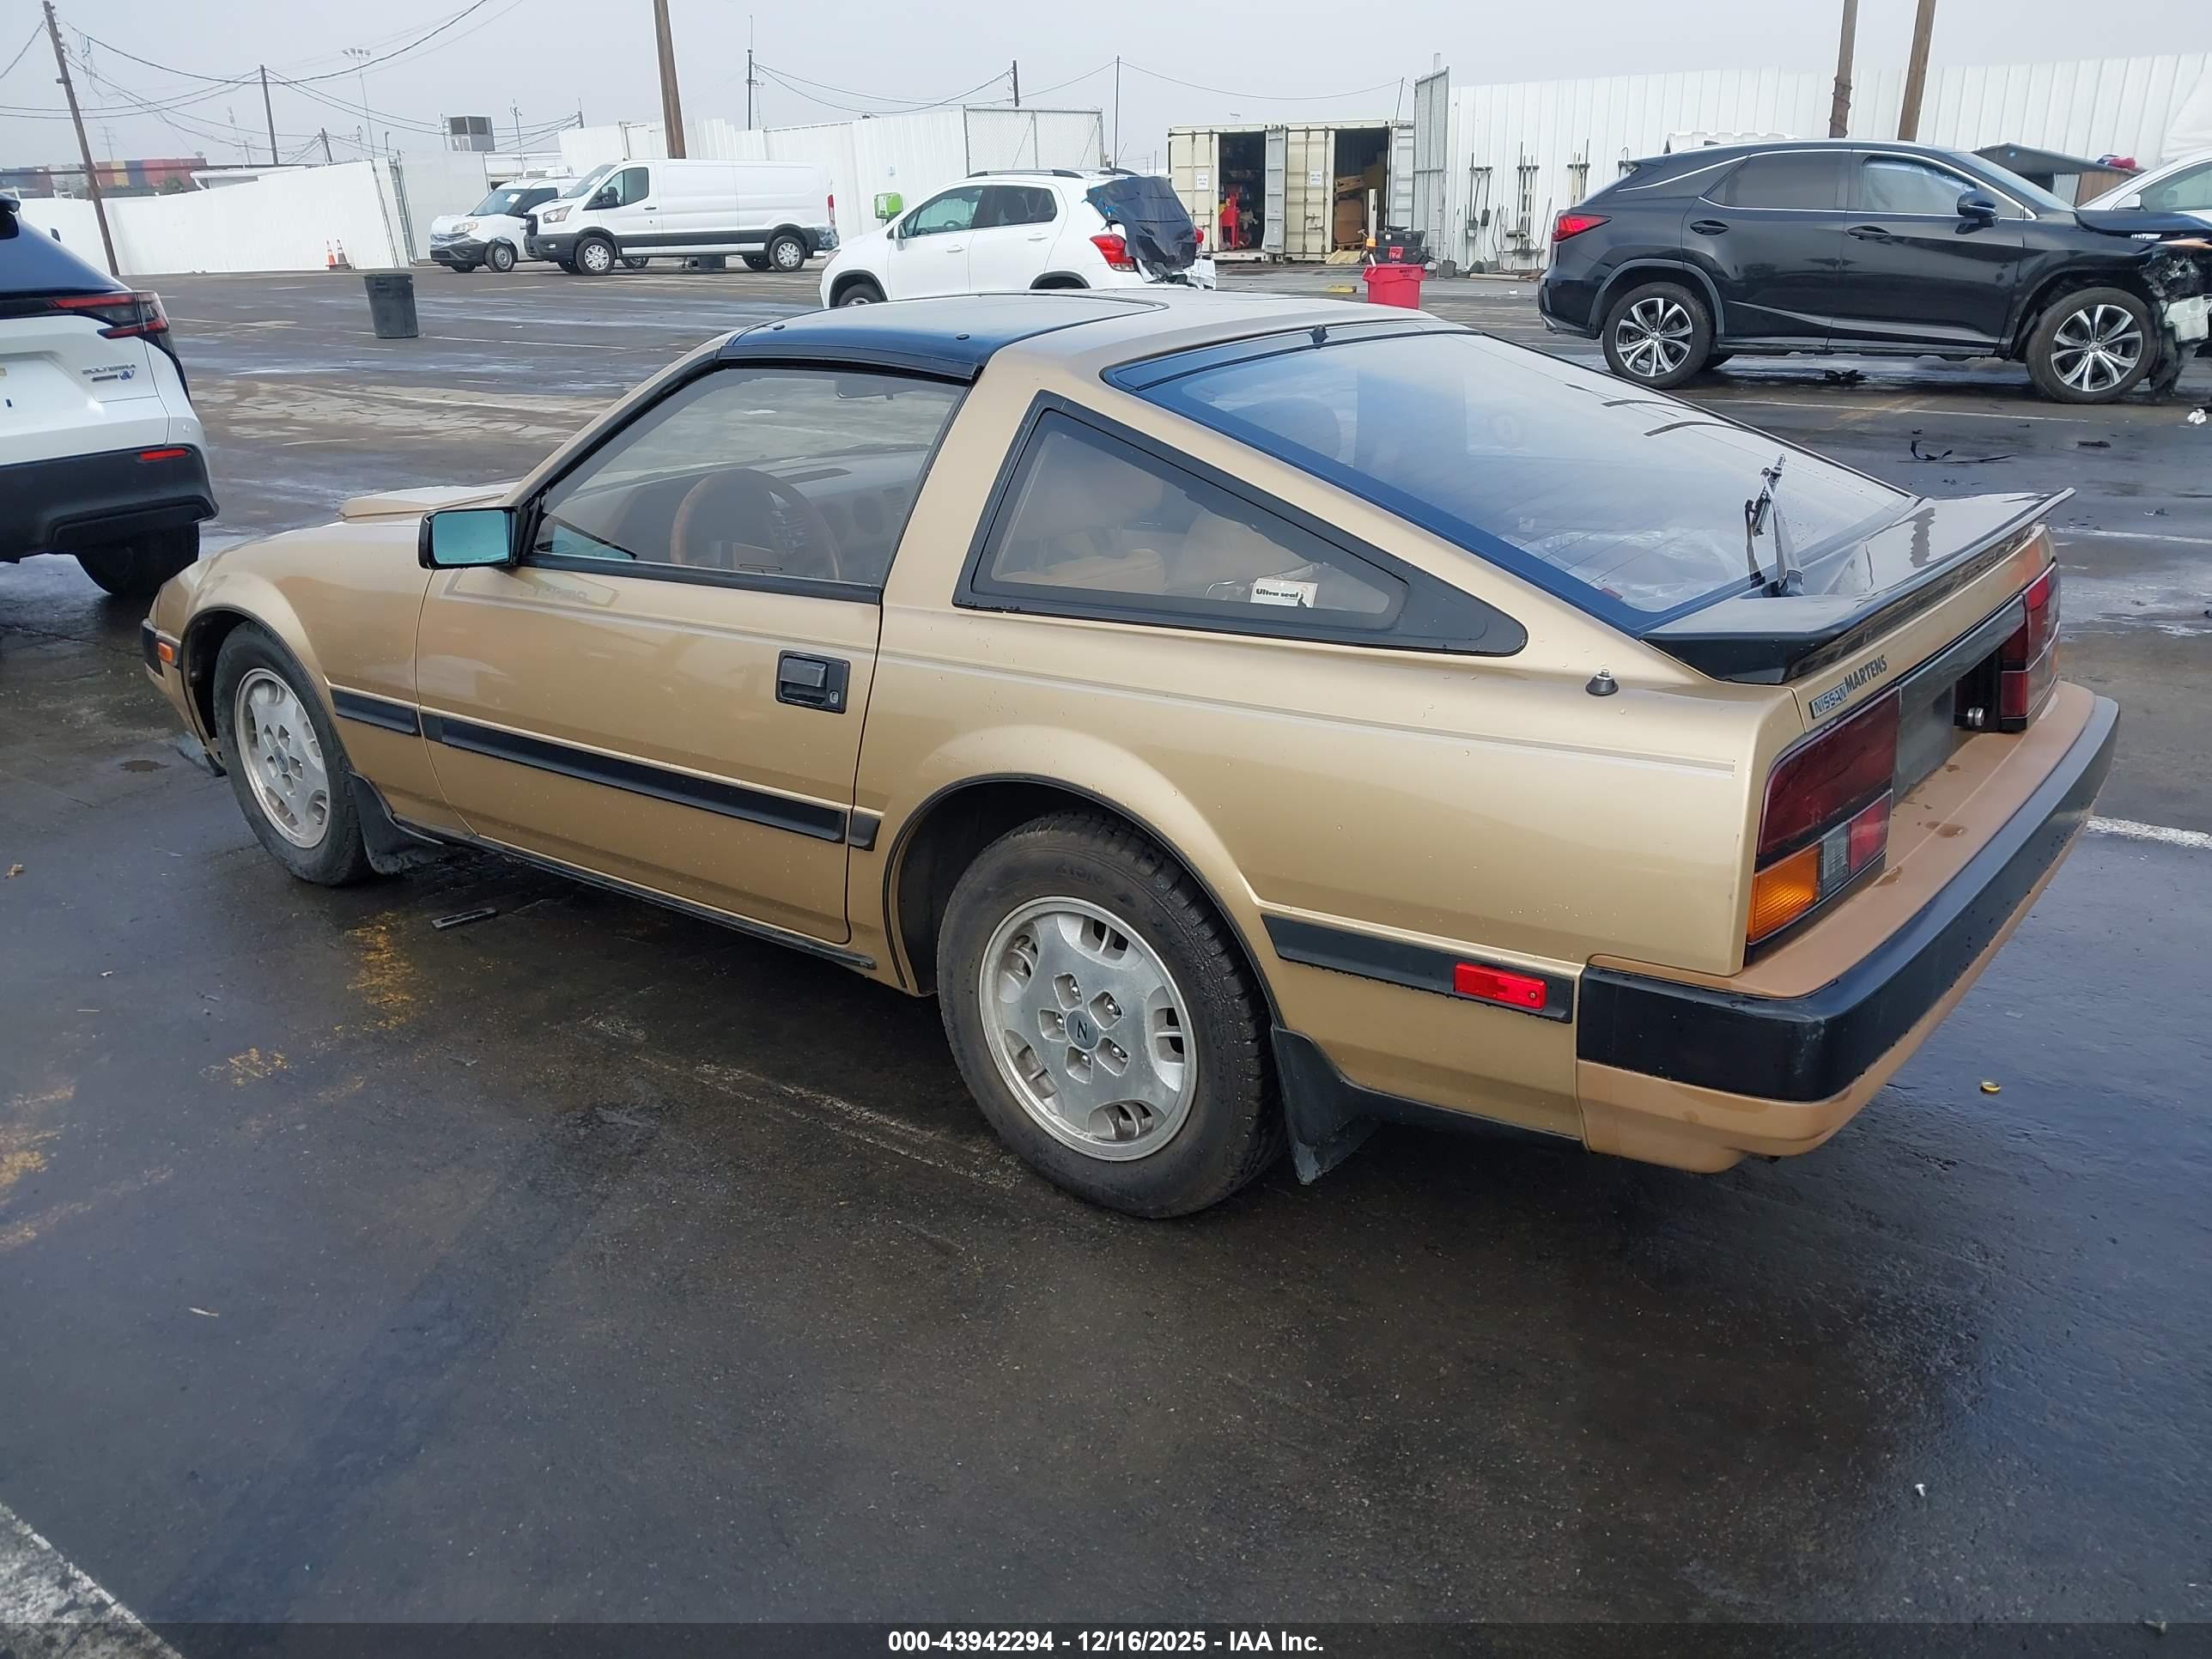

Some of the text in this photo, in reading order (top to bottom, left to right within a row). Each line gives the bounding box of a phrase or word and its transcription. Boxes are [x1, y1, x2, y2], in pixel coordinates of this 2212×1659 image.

[1255, 588, 1279, 597] Ultra
[1813, 654, 1887, 715] NISSAN MARTENS
